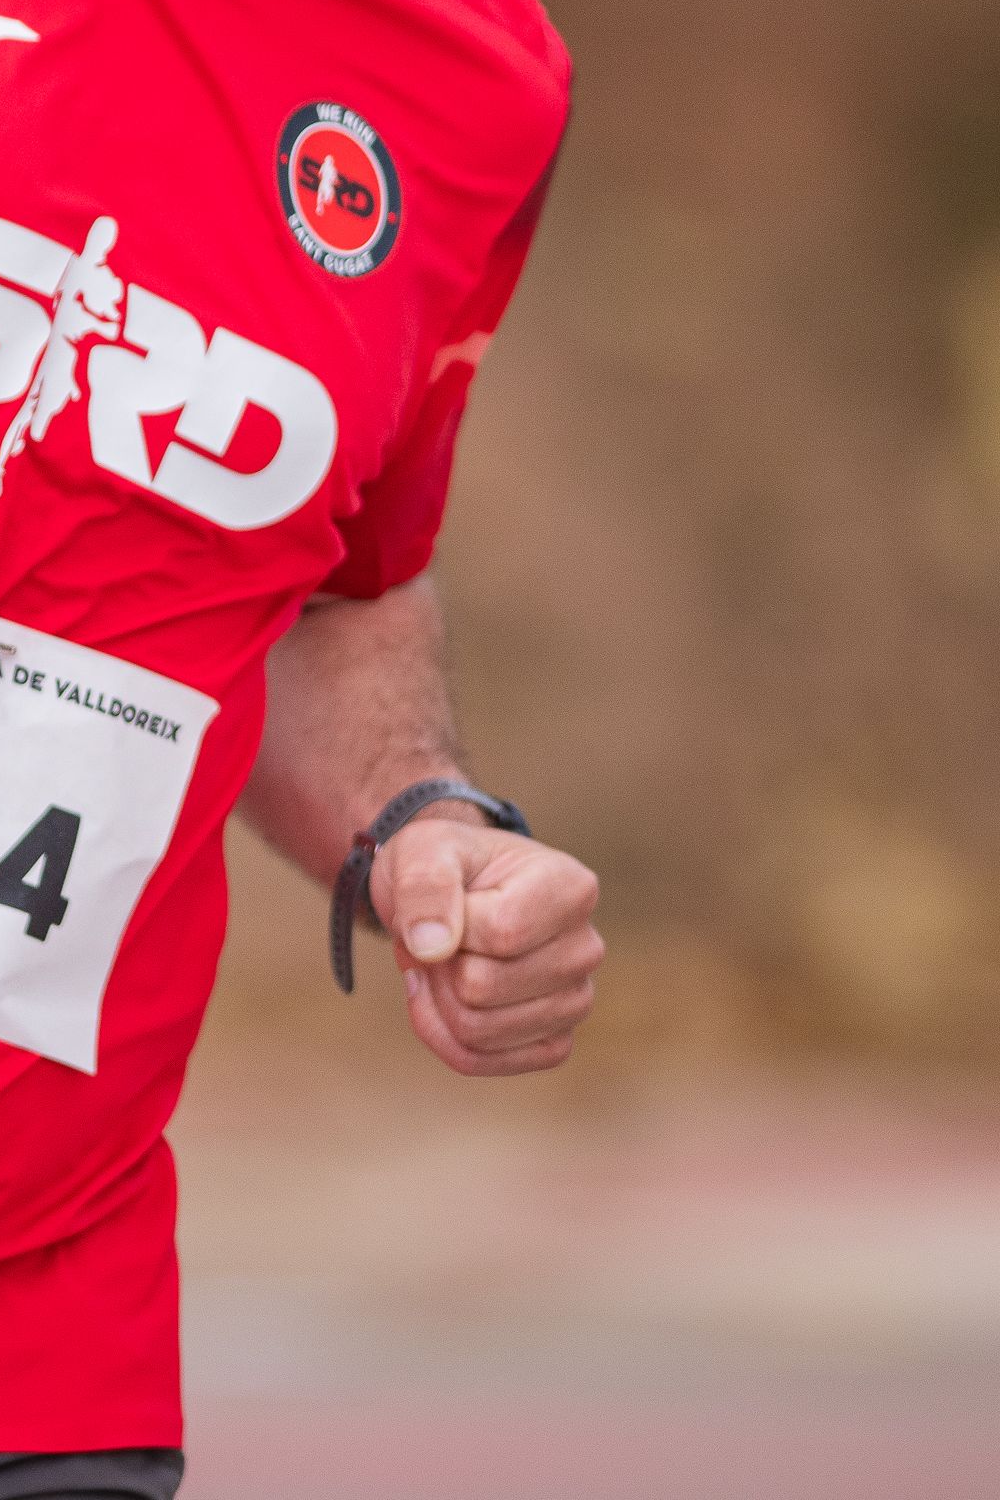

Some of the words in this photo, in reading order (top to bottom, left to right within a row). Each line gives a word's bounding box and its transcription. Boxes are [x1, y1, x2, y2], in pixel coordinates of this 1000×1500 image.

[316, 103, 342, 121] WE
[343, 110, 376, 148] RUN
[13, 664, 46, 692] DE
[55, 677, 182, 743] VALLDOREIX
